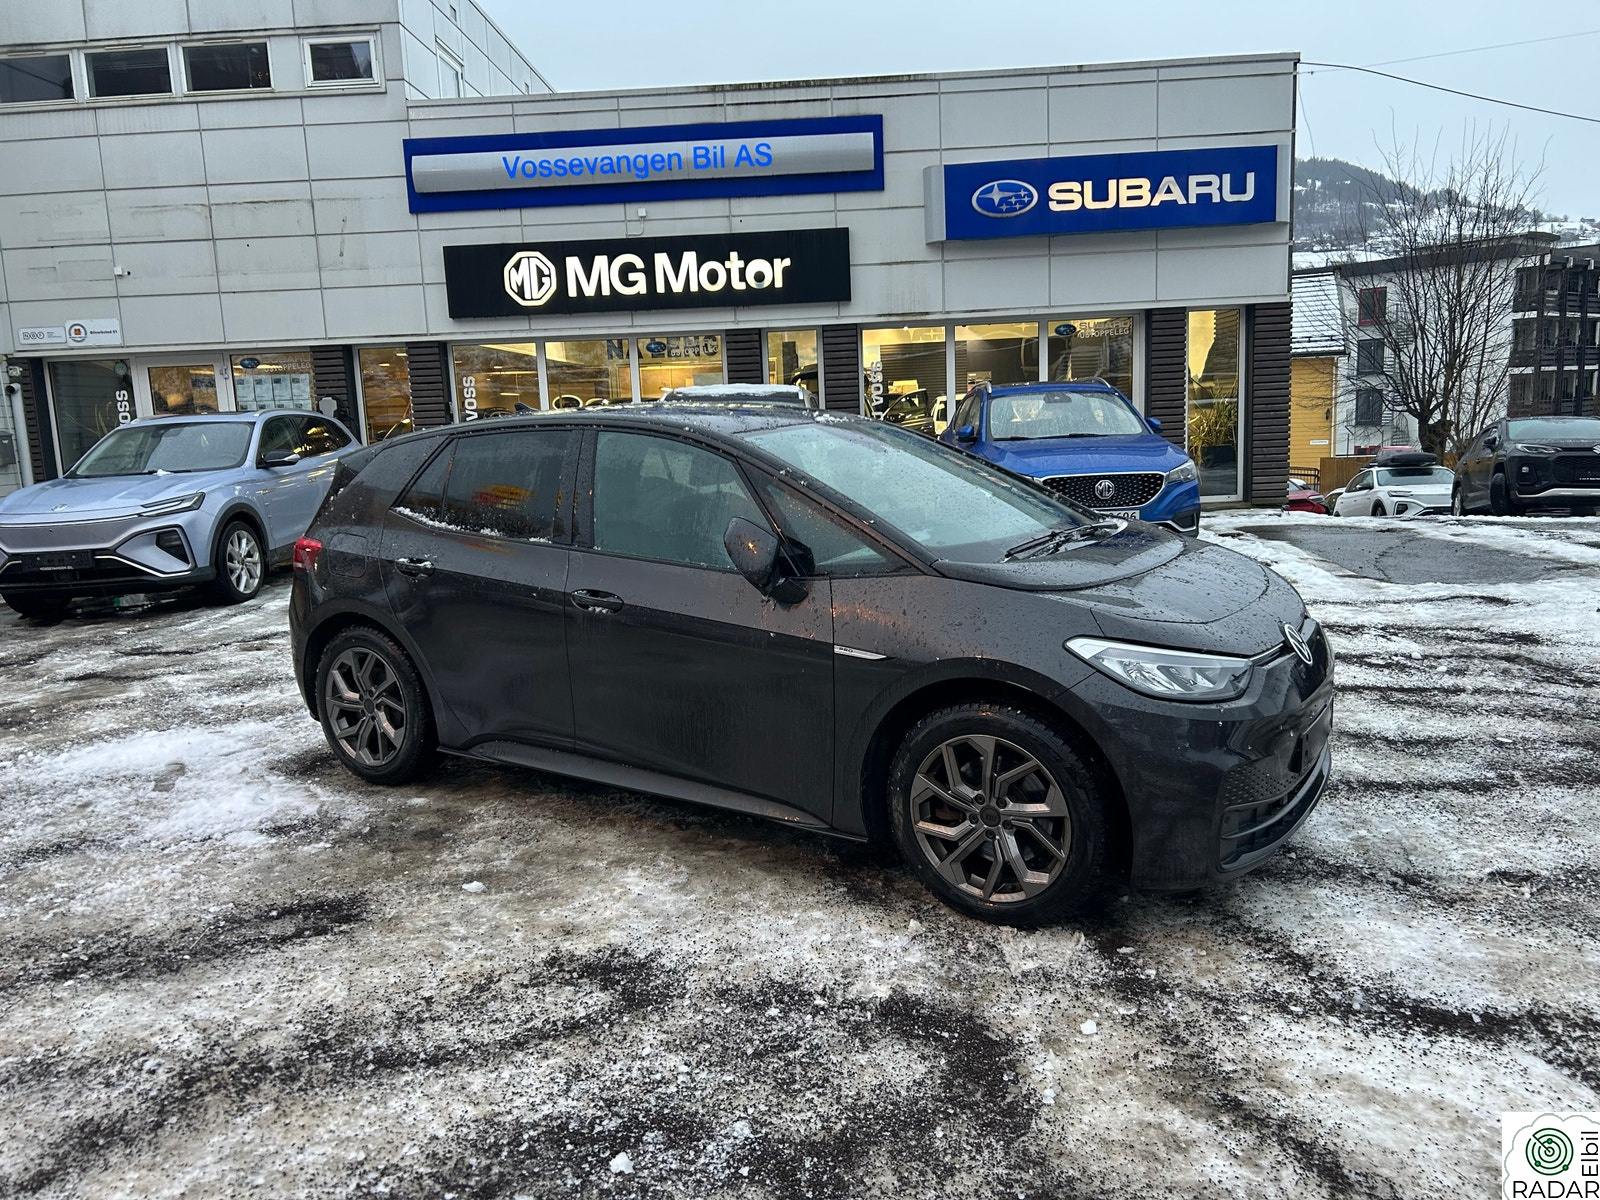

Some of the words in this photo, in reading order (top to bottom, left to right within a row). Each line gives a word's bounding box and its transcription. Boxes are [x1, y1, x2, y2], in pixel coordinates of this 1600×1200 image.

[502, 152, 683, 179] Vossevangen
[693, 144, 725, 170] Bil
[735, 142, 773, 168] AS
[1048, 172, 1256, 212] SUBARU
[507, 253, 553, 303] MG
[565, 253, 646, 298] MG
[655, 250, 791, 294] Motor
[462, 375, 479, 422] VOSS
